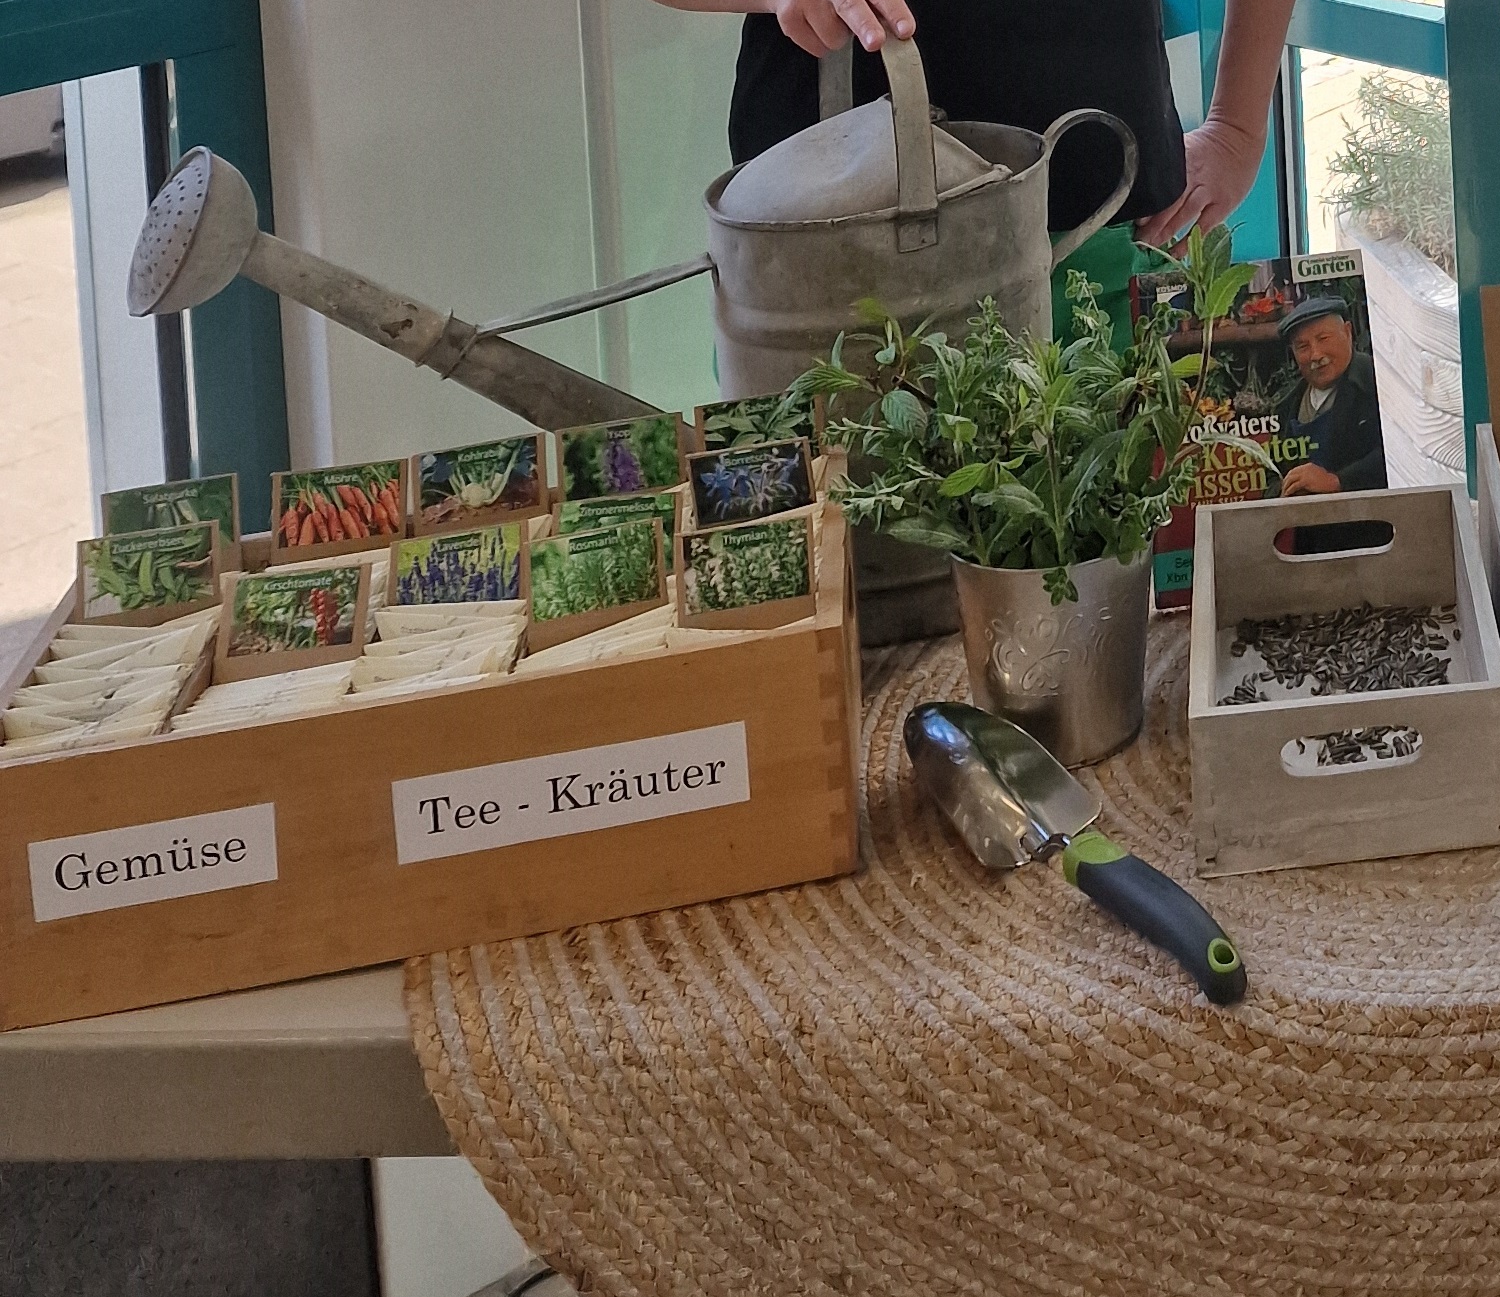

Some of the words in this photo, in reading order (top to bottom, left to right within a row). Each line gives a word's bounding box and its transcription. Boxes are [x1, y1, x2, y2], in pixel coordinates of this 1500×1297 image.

[1297, 259, 1357, 277] Garten
[1182, 413, 1281, 444] roßvaters
[1194, 467, 1269, 500] issen
[568, 535, 619, 553] Rosmarin
[722, 530, 768, 547] Thymian
[262, 574, 334, 592] Kirschtomate
[418, 795, 501, 836] Tee
[517, 802, 530, 810] -
[546, 759, 727, 815] Kräuter
[54, 837, 248, 892] Gemüse
